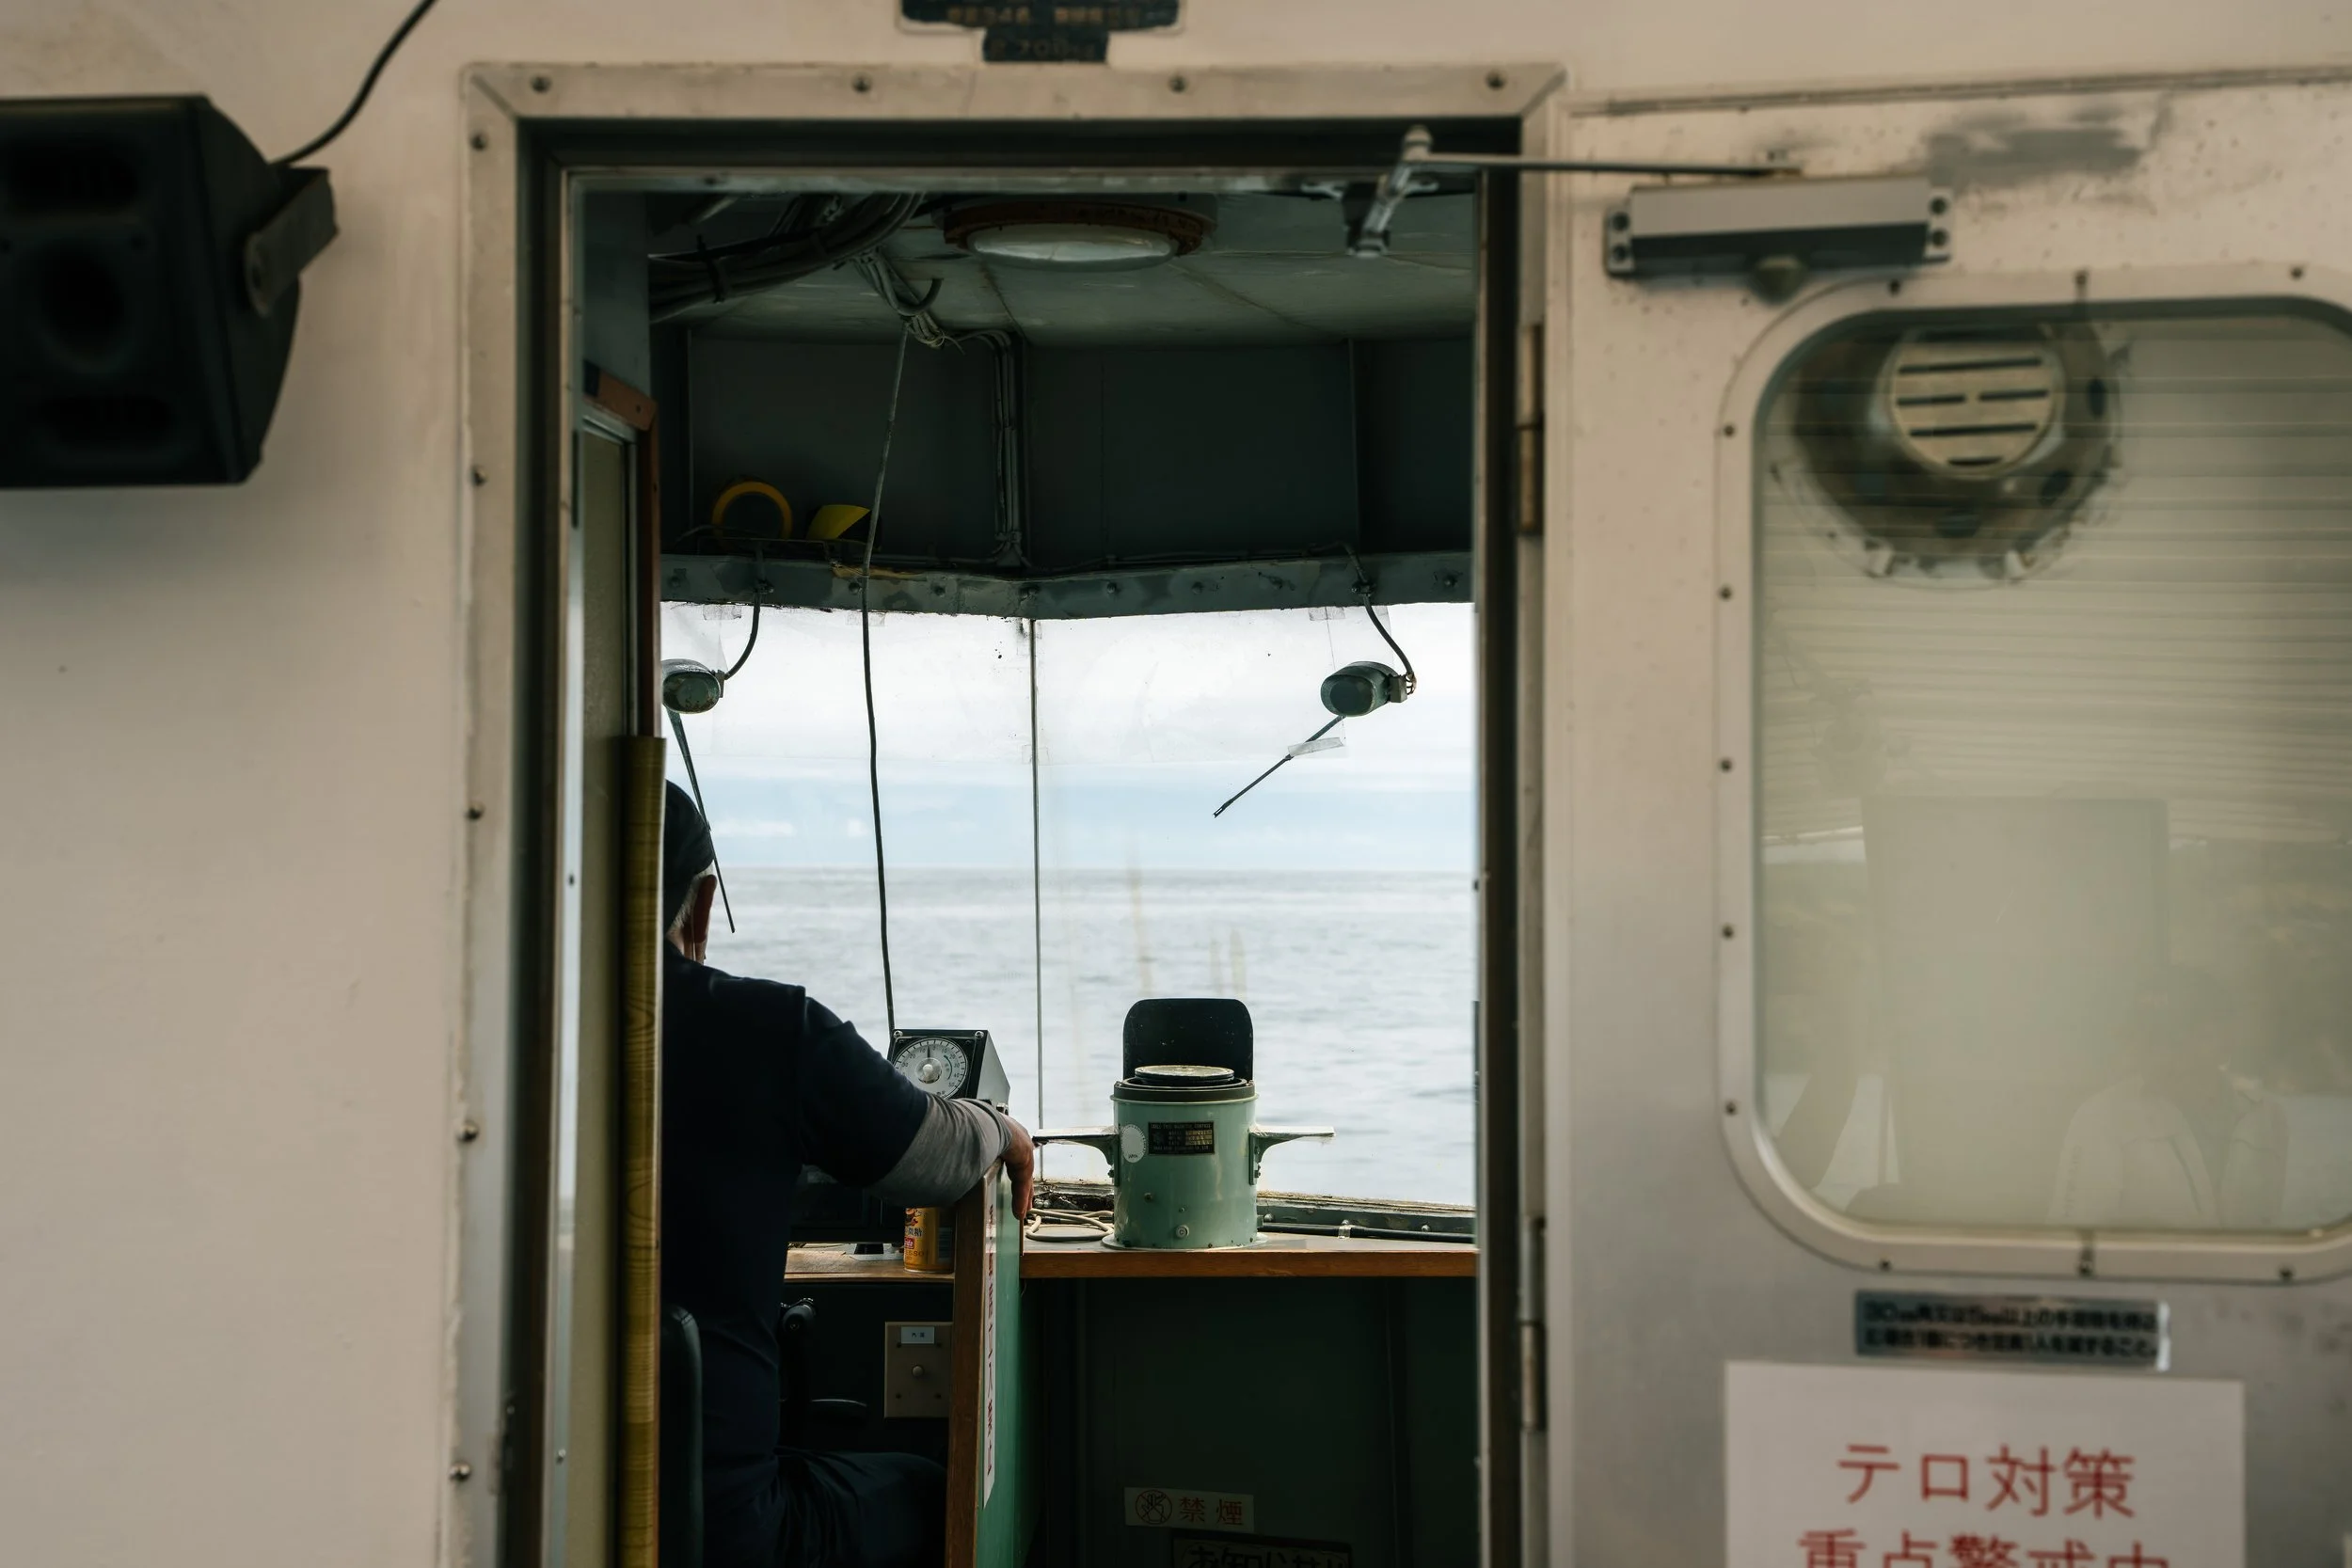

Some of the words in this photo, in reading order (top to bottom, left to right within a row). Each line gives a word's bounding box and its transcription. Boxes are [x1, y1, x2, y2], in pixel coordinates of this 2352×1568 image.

[1837, 1444, 2136, 1520] テロ対策
[1179, 1497, 1244, 1526] 禁煙
